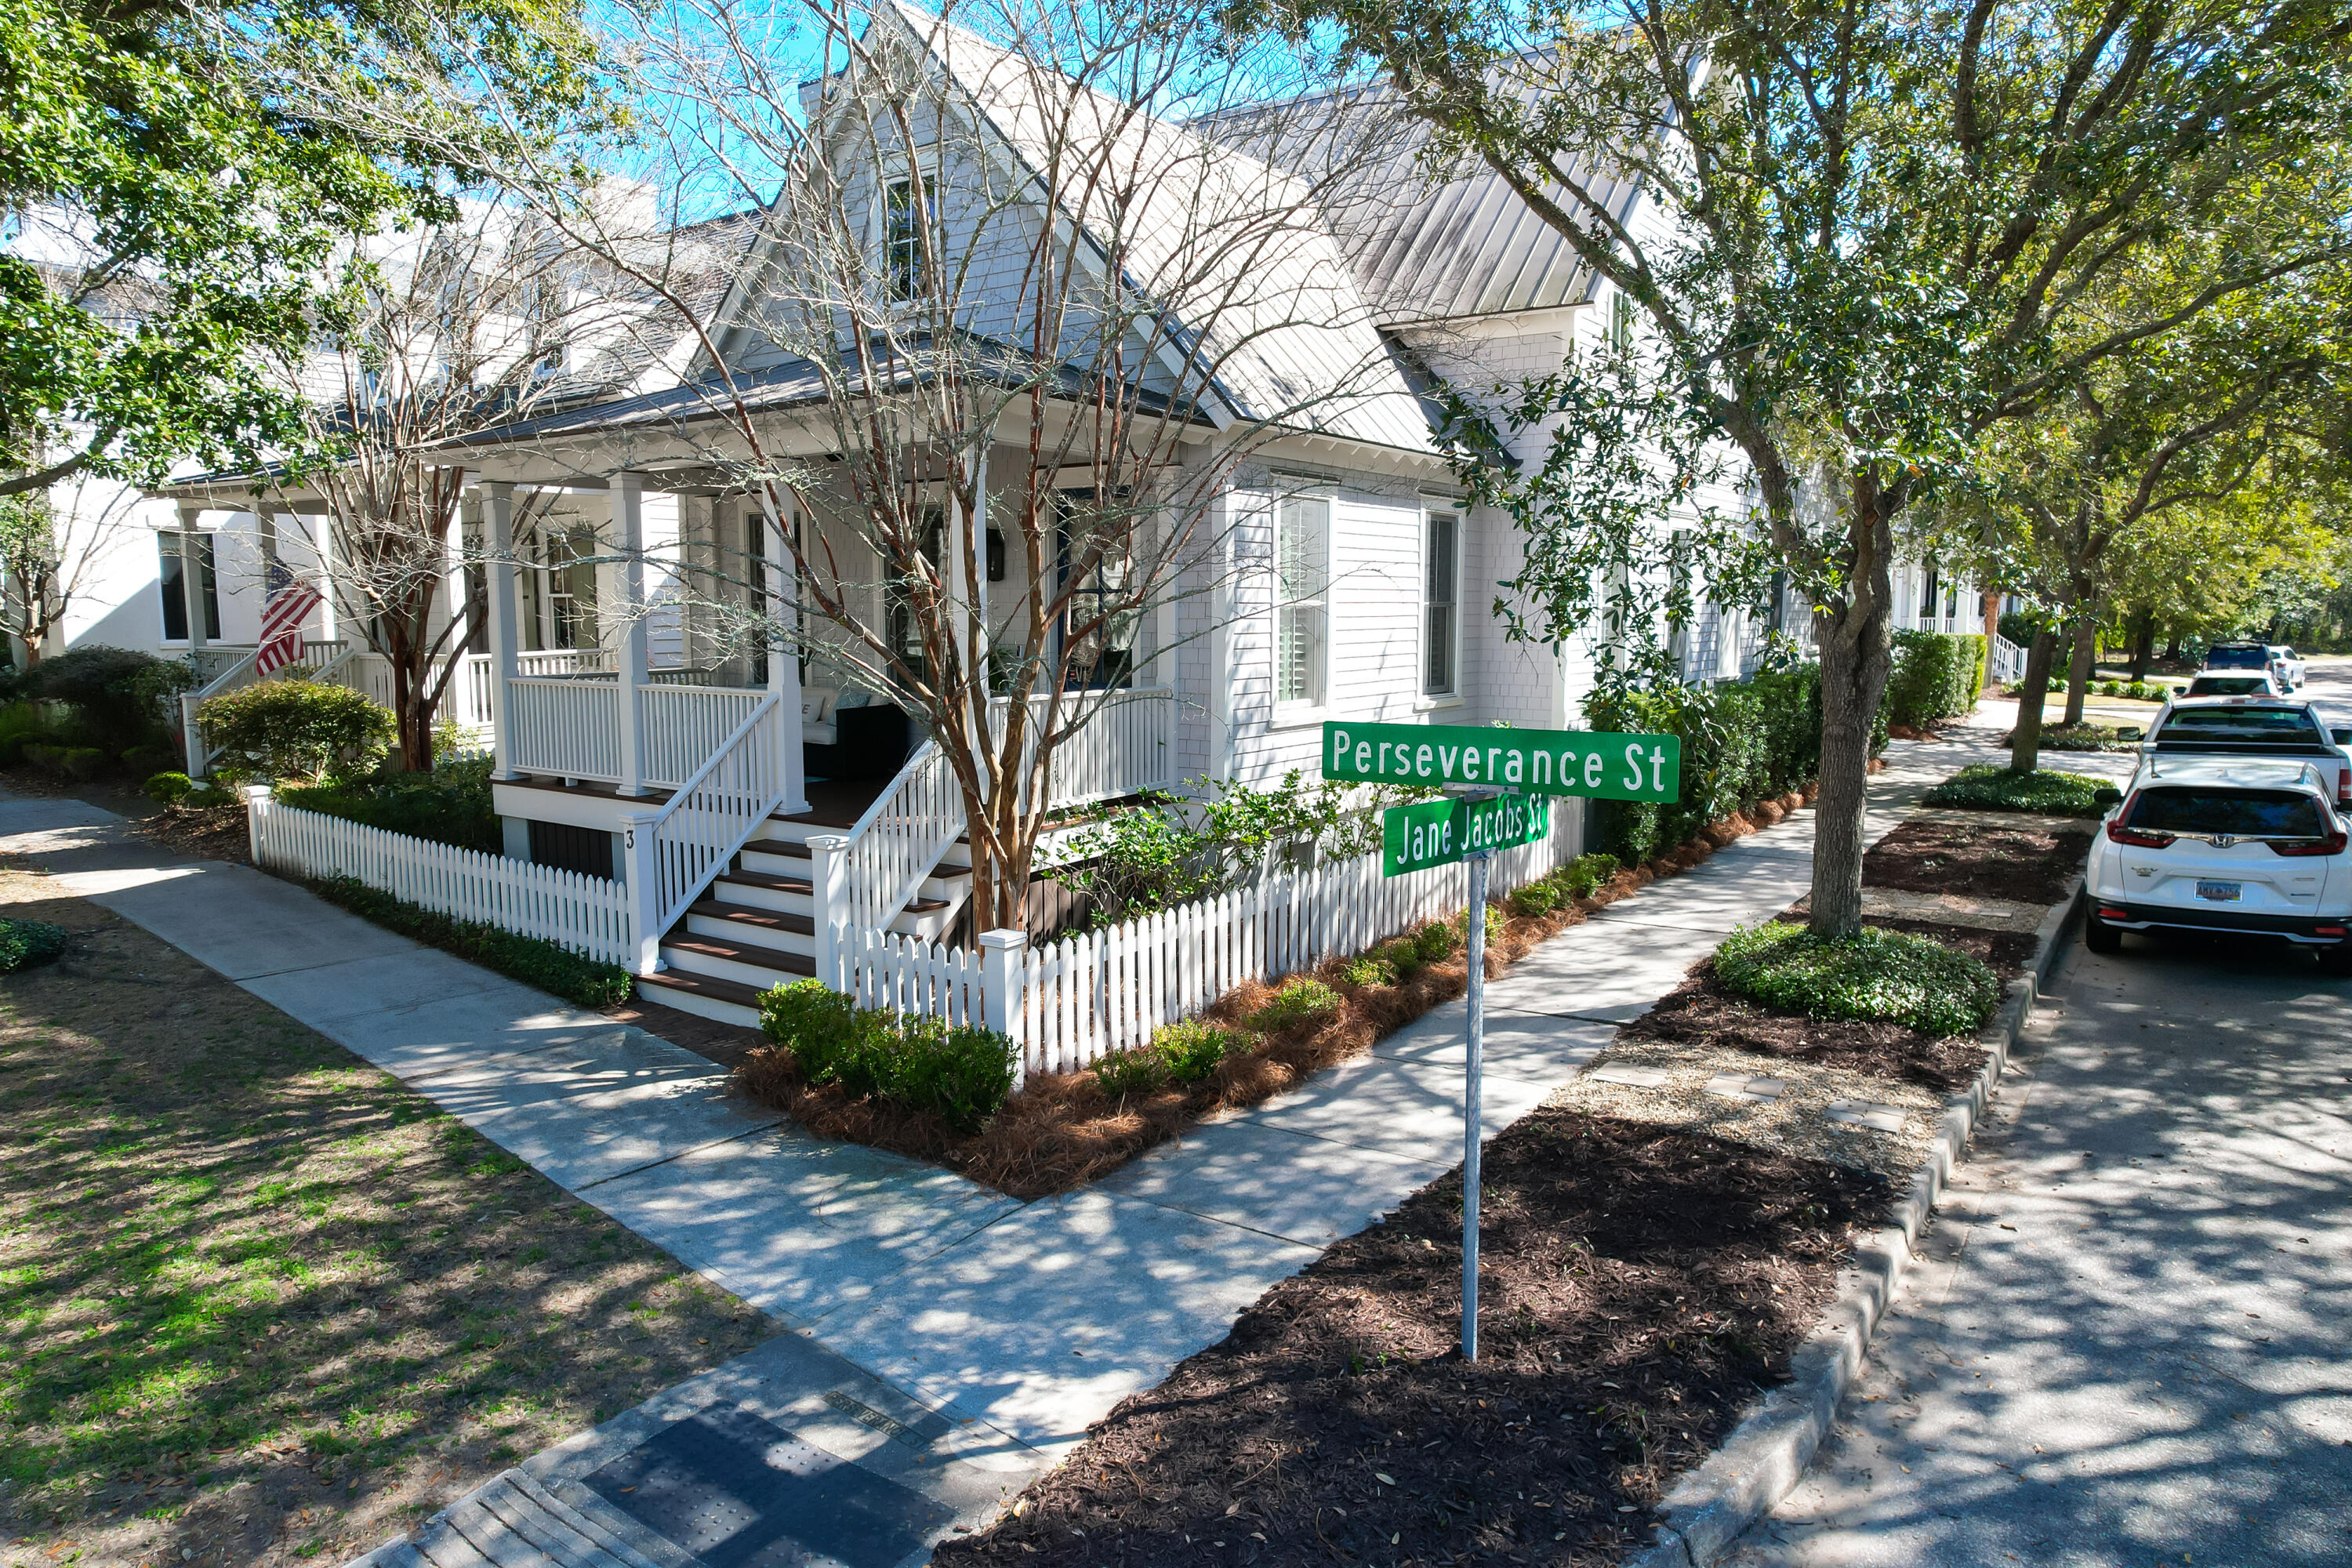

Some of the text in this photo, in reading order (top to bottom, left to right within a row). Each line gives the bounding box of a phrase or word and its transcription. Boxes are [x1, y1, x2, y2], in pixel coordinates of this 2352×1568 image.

[1333, 730, 1666, 793] Perseverance St
[626, 829, 634, 849] 3
[1396, 793, 1543, 865] Jane Jacobs St
